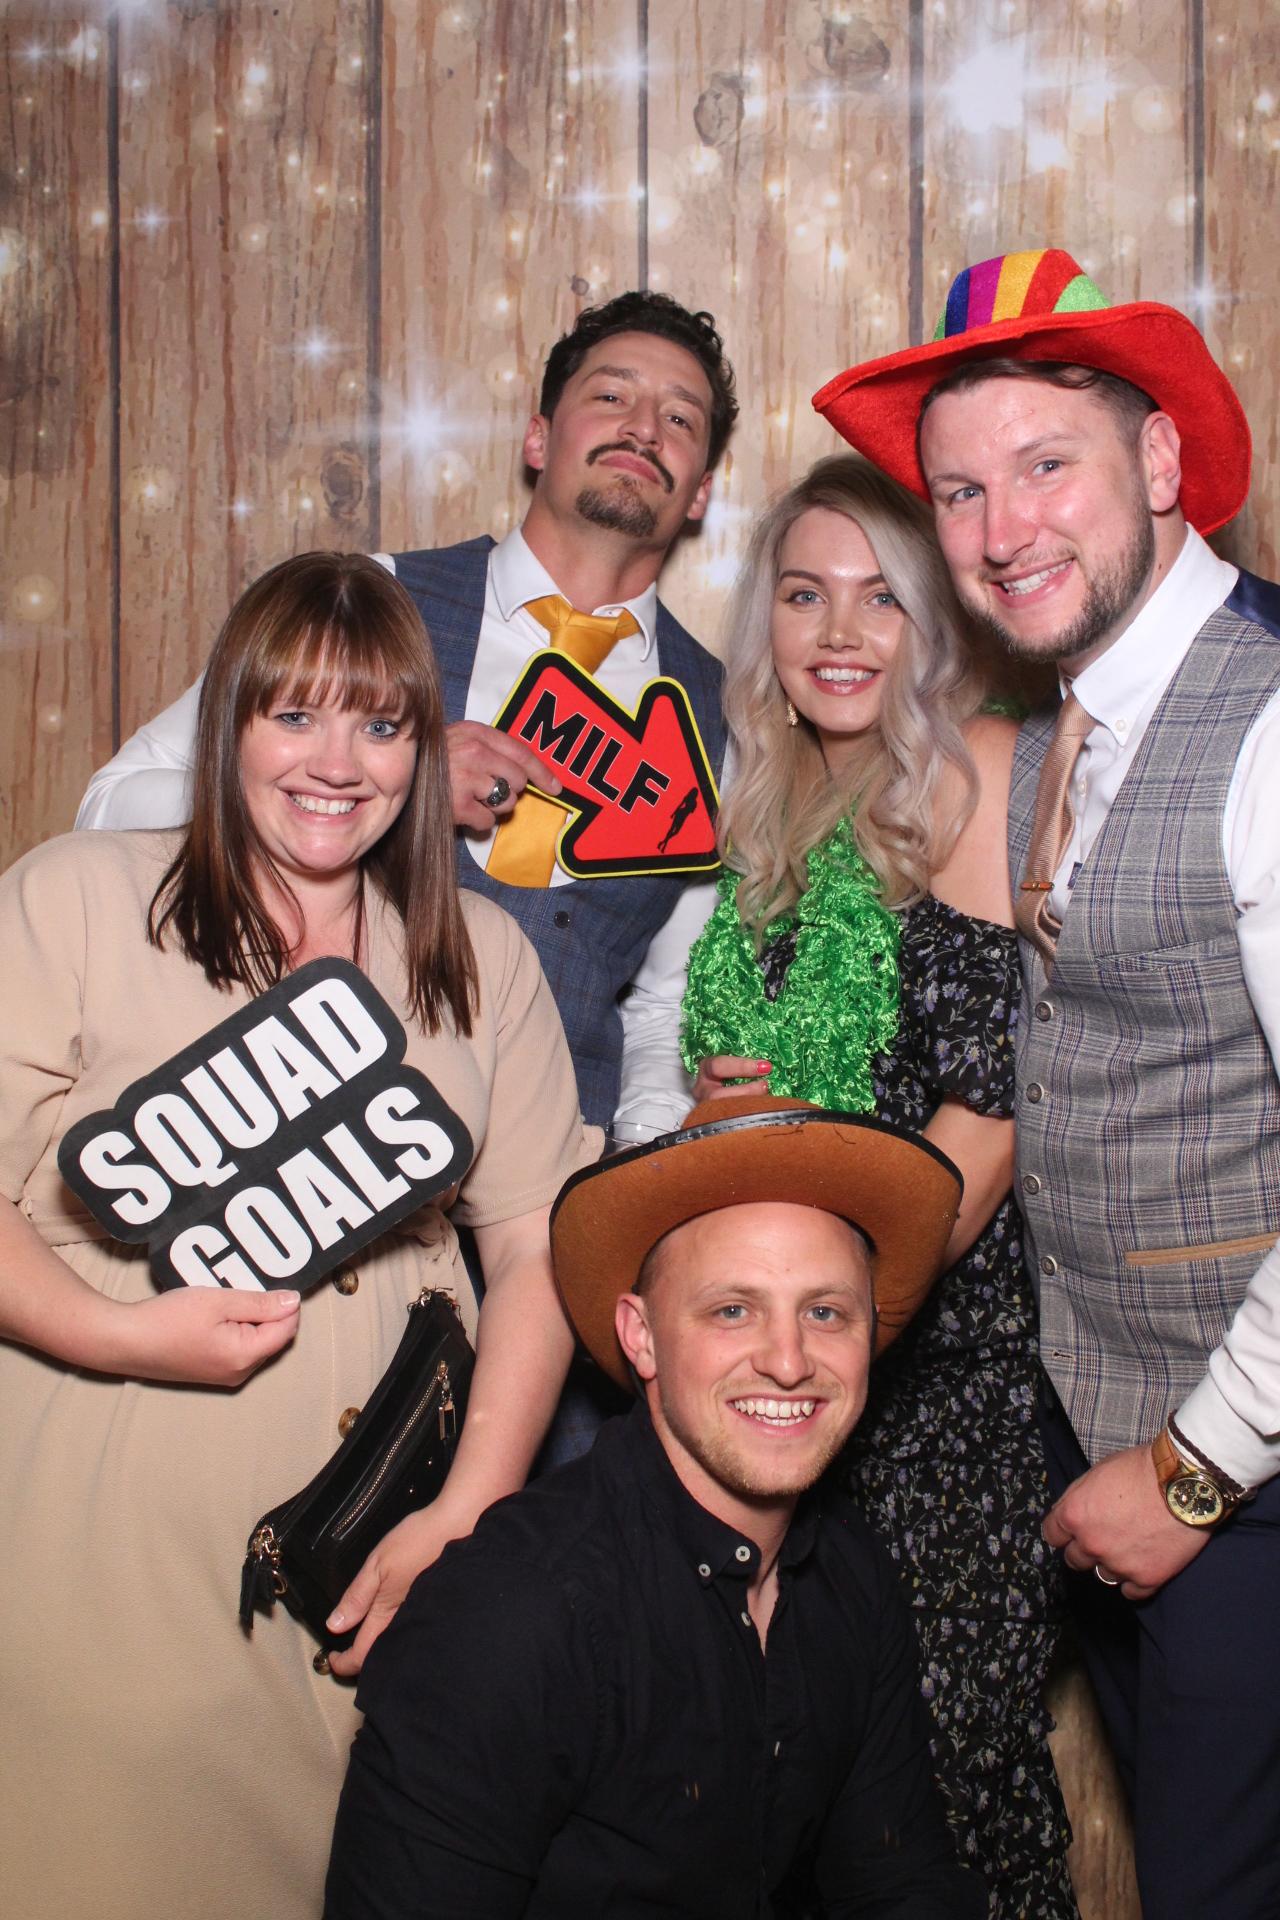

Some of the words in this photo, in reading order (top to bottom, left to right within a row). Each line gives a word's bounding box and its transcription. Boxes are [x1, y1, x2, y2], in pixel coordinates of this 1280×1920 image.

[519, 689, 671, 814] MILF
[79, 978, 388, 1225] SQUAD
[169, 1086, 455, 1292] GOALS
